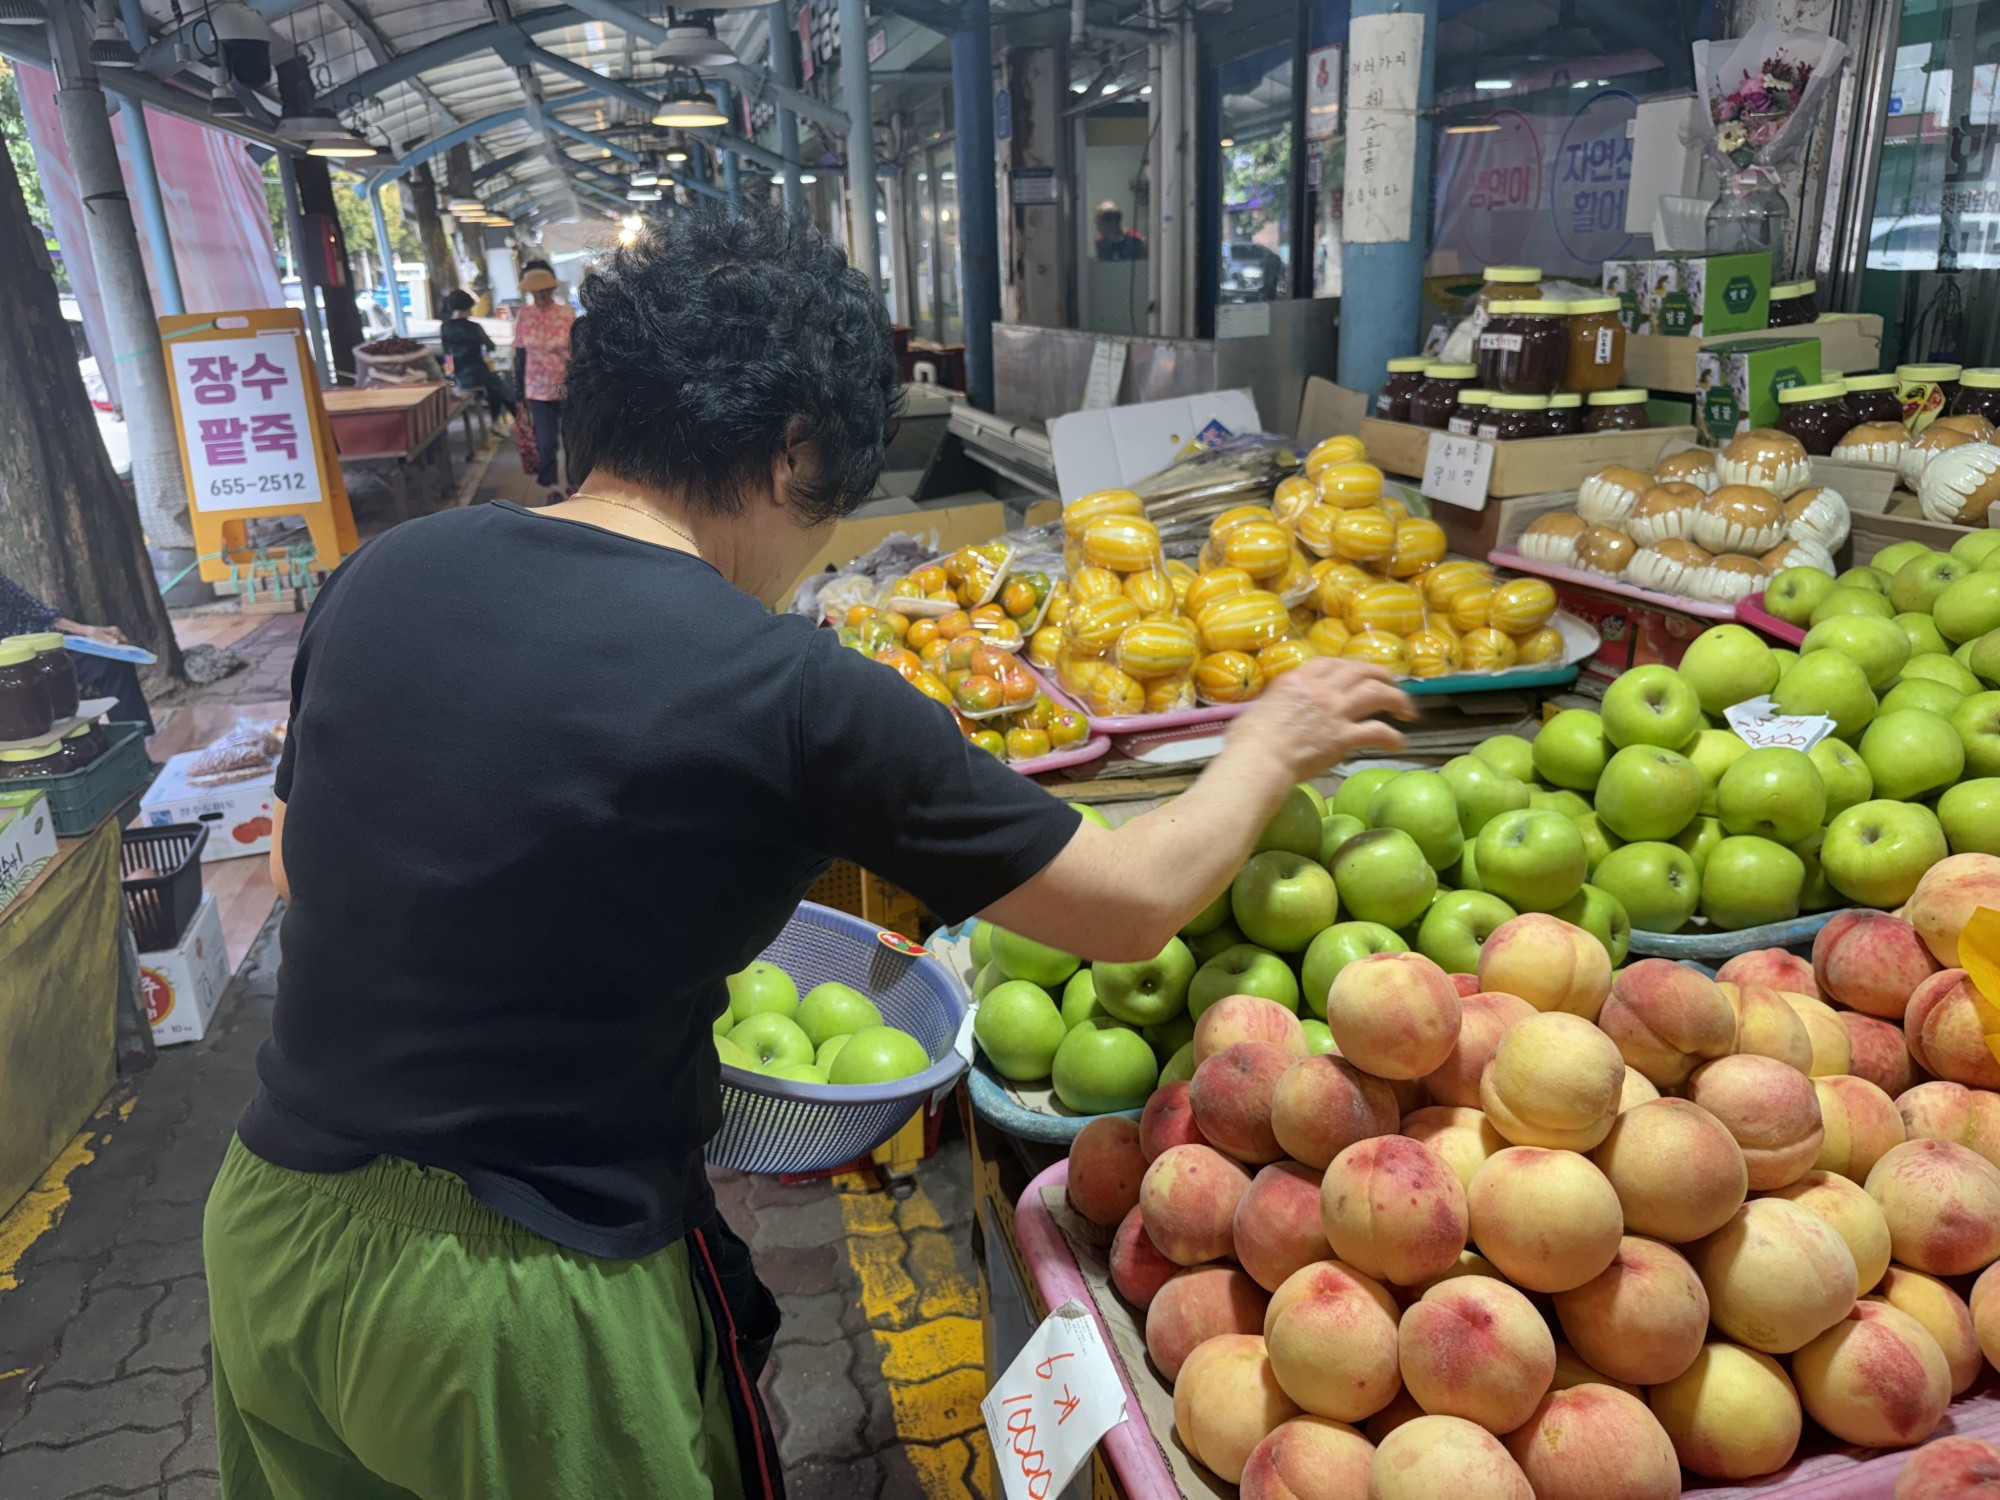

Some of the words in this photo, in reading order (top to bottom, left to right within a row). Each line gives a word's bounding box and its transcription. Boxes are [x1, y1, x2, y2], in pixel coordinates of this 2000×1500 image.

[1573, 189, 1626, 234] 활어
[1664, 310, 1687, 326] 벌꿀
[187, 353, 288, 405] 장수
[1710, 404, 1733, 421] 벌꿀
[198, 413, 298, 467] 팥죽
[210, 472, 306, 496] 655-2512
